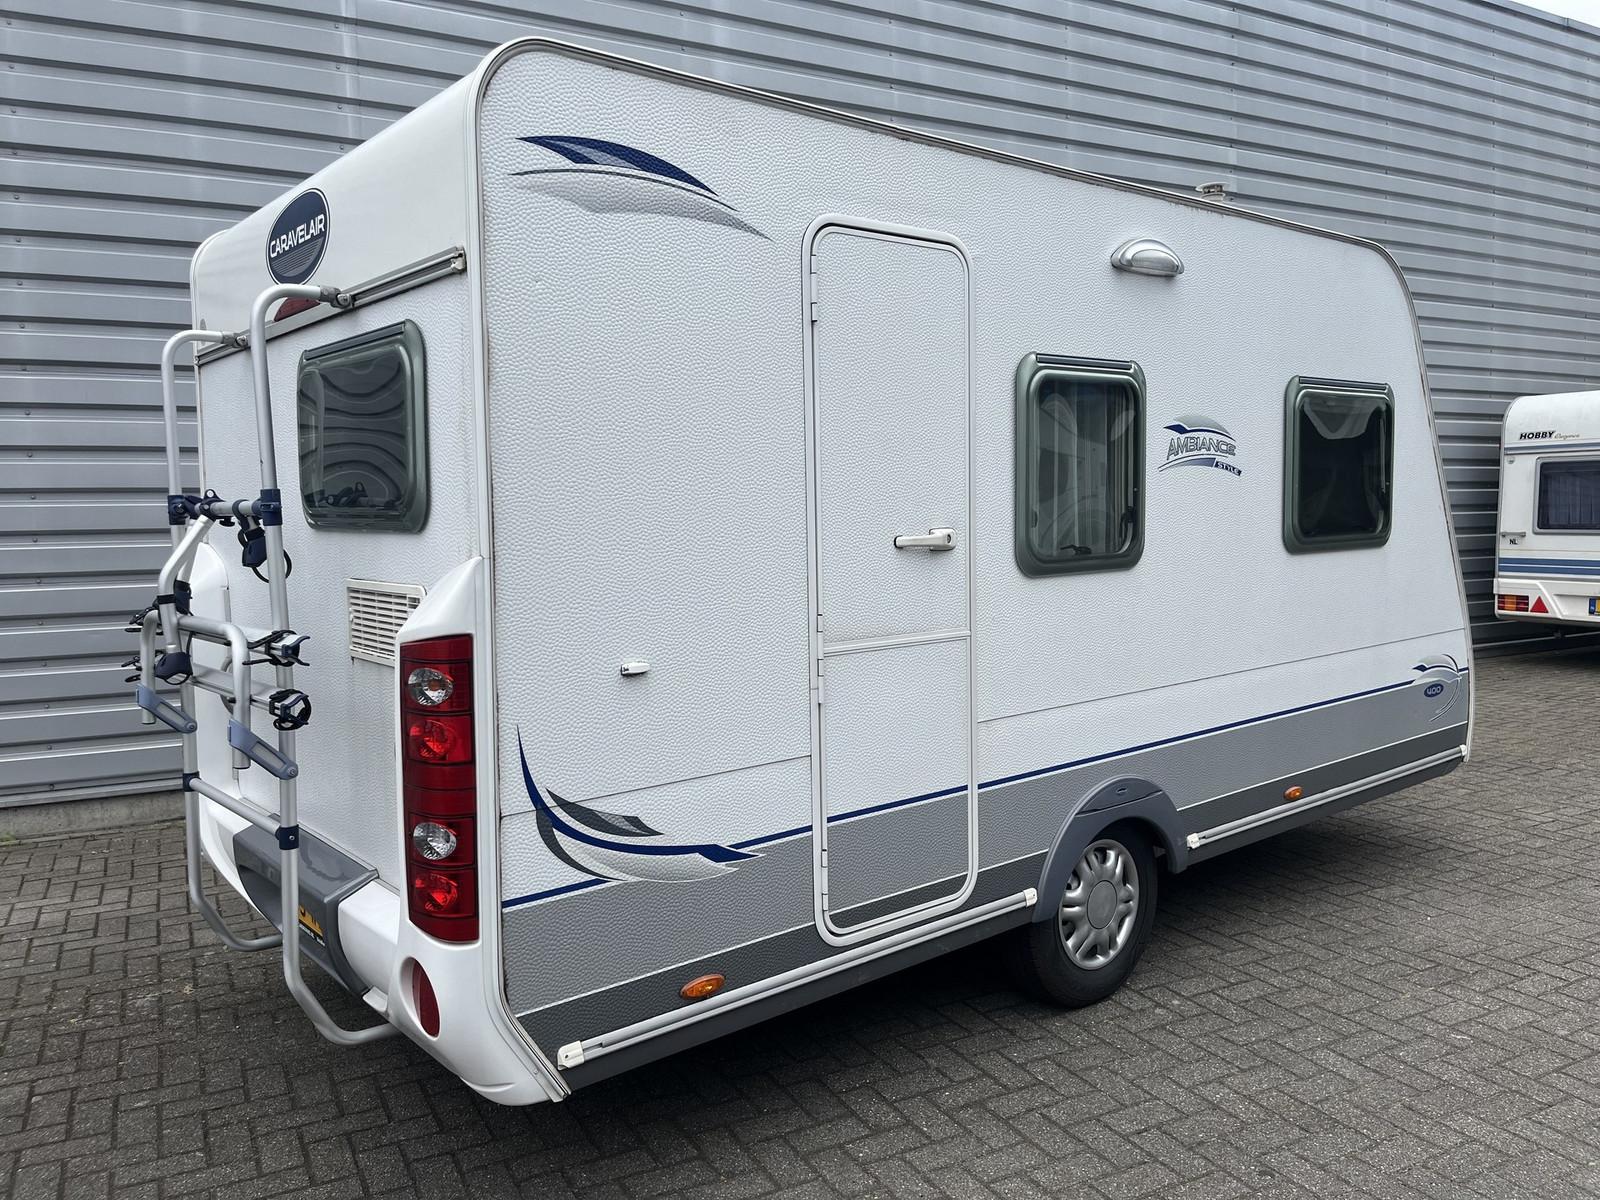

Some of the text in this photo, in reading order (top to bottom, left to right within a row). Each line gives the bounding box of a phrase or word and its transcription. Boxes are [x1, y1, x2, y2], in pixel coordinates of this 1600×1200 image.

[269, 213, 325, 258] CARAVELAIR
[1519, 430, 1556, 440] HOBBY
[1166, 436, 1236, 461] AMBIANCE
[1217, 462, 1240, 475] STYLE
